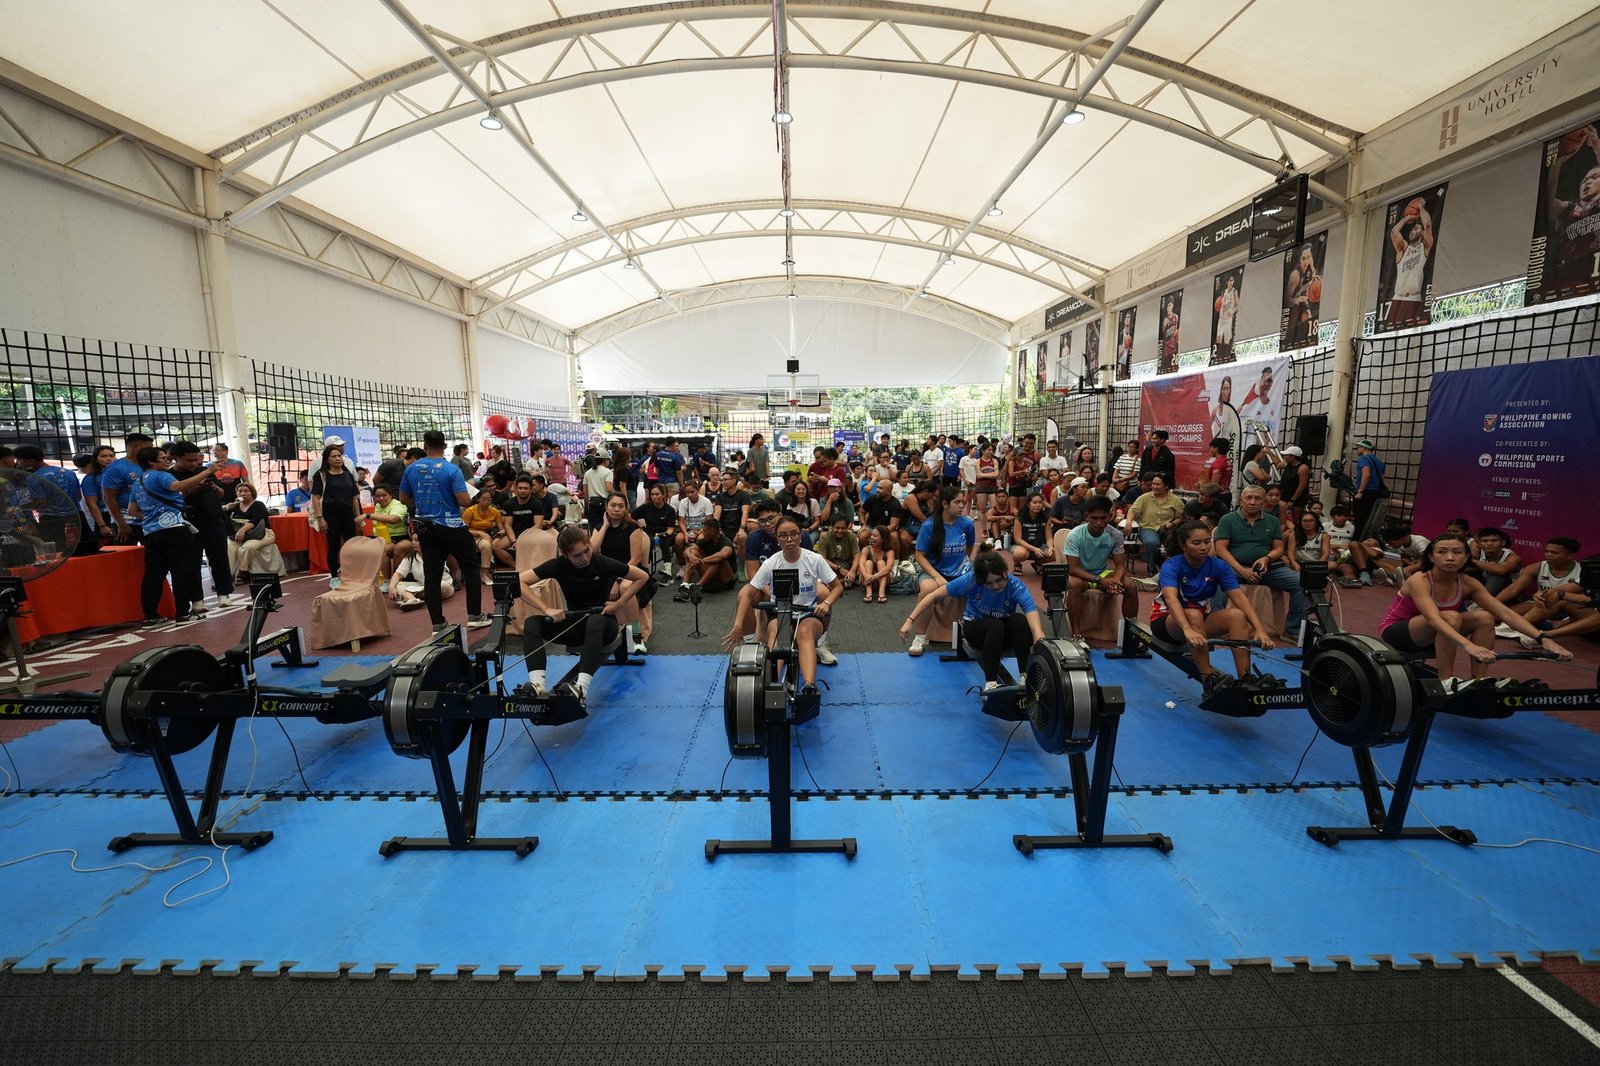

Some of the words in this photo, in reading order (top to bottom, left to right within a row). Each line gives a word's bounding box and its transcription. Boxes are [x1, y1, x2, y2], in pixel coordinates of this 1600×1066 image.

[1468, 54, 1562, 111] UNIVERSITY
[1484, 84, 1535, 115] HOTEL
[1546, 153, 1558, 168] 87
[1277, 220, 1294, 231] GUEST
[1527, 236, 1547, 290] ABADIANO
[1378, 301, 1392, 321] 17
[1307, 319, 1319, 337] 18
[1505, 399, 1539, 407] PRESENTED
[1500, 413, 1540, 421] PHILIPPINE
[1542, 412, 1572, 420] ROWING
[1177, 423, 1204, 433] COURSES.
[1178, 434, 1203, 443] CHAMPS.
[1495, 453, 1534, 461] PHILIPPINE
[1536, 454, 1565, 462] SPORTS
[1493, 460, 1536, 468] COMMISSION
[1511, 477, 1543, 485] PARTNERS:
[1483, 505, 1514, 514] HYDRATION
[1514, 508, 1543, 517] PARTNER:
[1514, 538, 1543, 548] PARTNER:
[1524, 694, 1592, 705] concept
[23, 703, 88, 715] concept
[90, 704, 100, 714] 2
[278, 701, 323, 711] concept
[323, 701, 330, 710] 2
[514, 704, 543, 714] concept
[541, 704, 547, 713] 2
